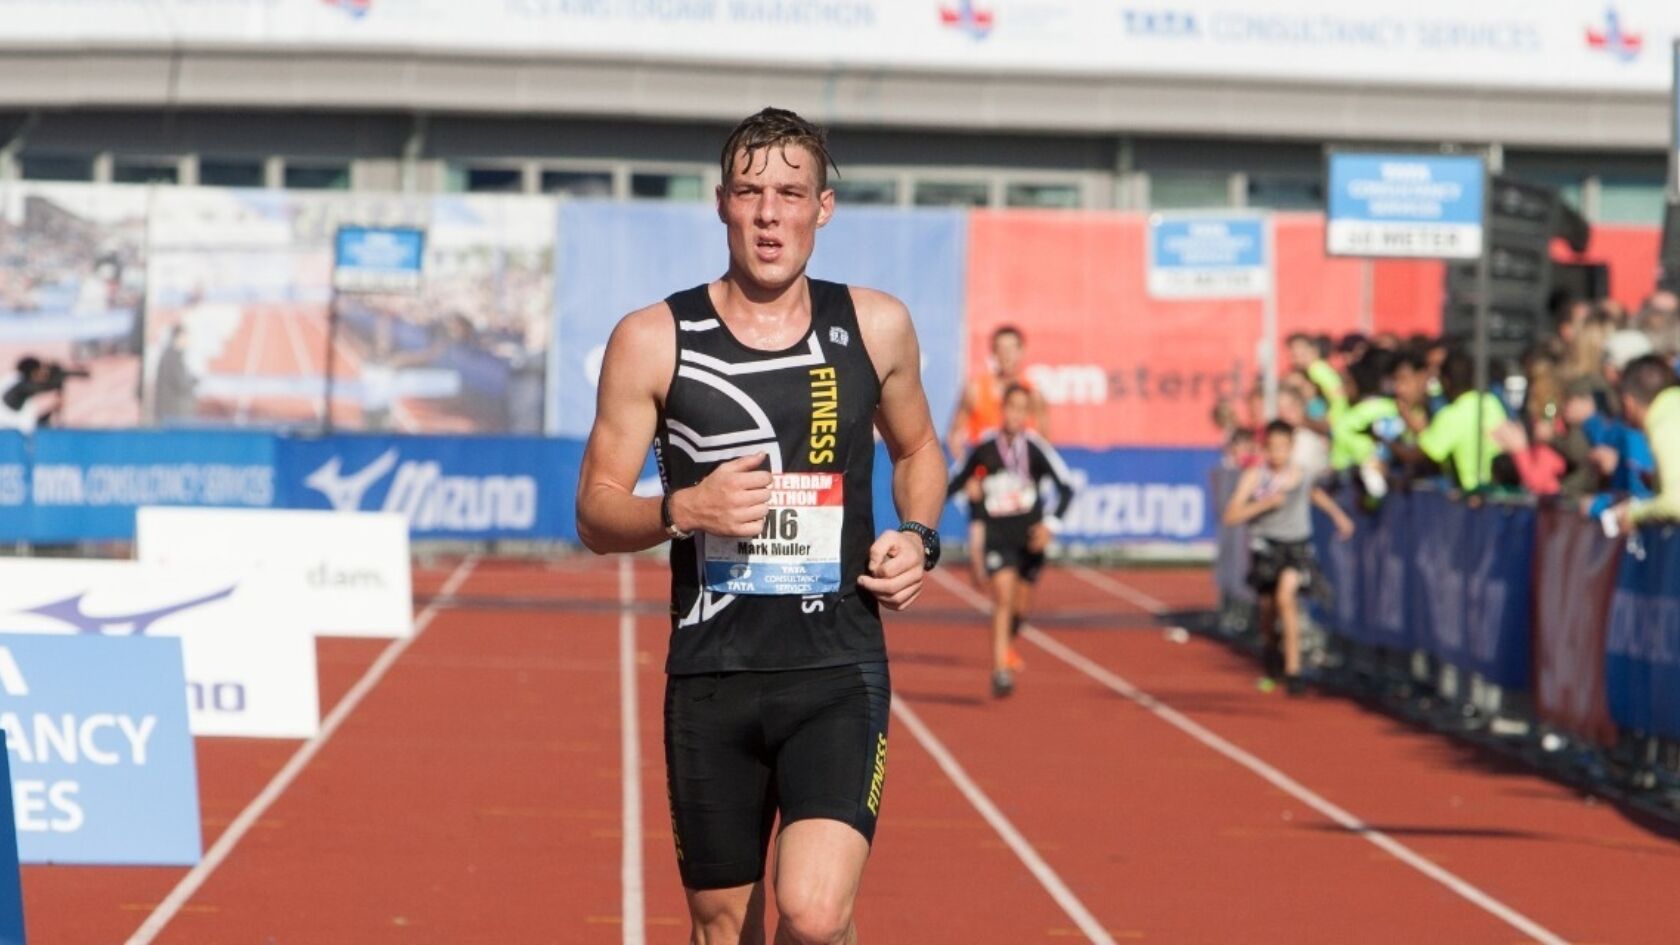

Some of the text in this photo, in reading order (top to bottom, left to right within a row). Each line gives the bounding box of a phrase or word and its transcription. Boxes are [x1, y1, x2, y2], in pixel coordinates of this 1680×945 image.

[809, 367, 838, 465] FITNESS
[737, 541, 811, 556] Mark Muller
[782, 566, 806, 574] TATA
[726, 581, 755, 592] TATA
[867, 732, 887, 816] FITNESS
